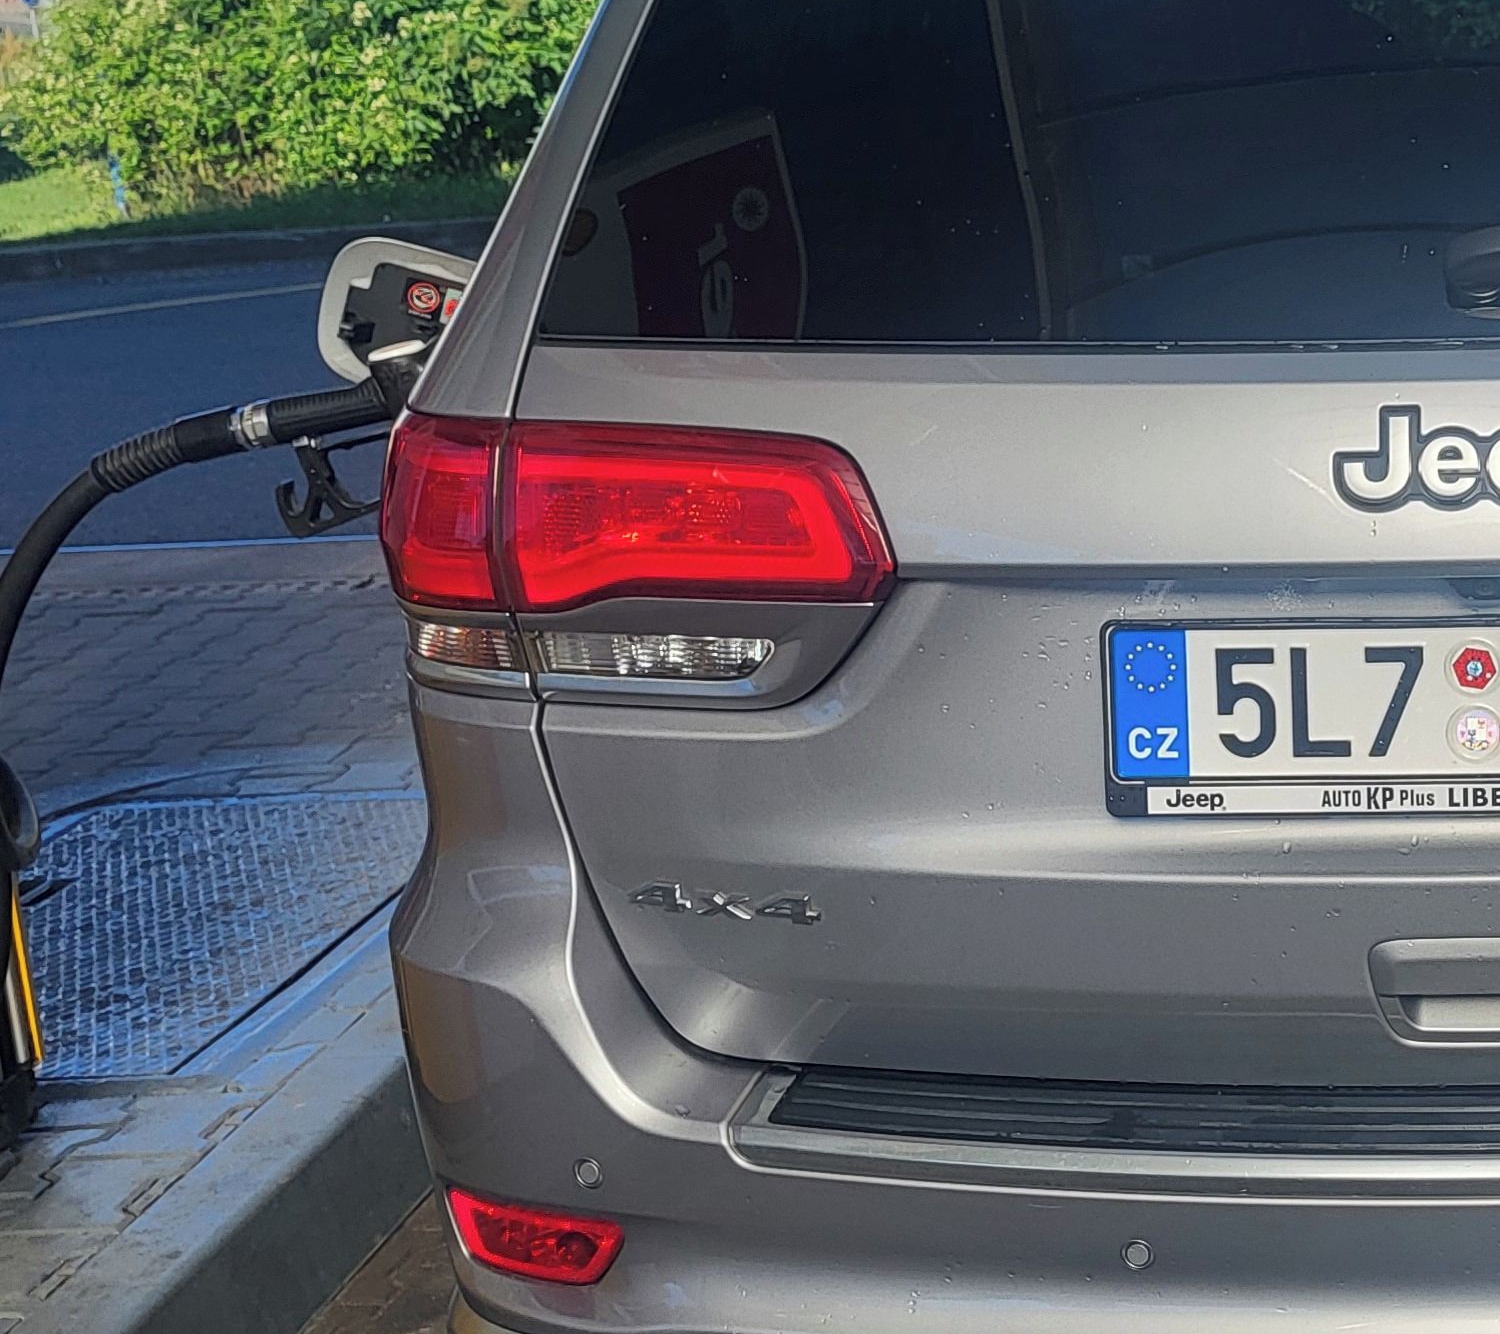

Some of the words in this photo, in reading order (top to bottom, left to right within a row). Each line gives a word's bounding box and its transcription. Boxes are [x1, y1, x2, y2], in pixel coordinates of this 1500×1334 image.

[1128, 727, 1180, 759] CZ
[1213, 645, 1426, 758] 5L7
[1165, 788, 1225, 811] Jeep
[1321, 789, 1361, 808] AUTO
[1366, 786, 1394, 810] KP
[1399, 788, 1436, 807] Plus
